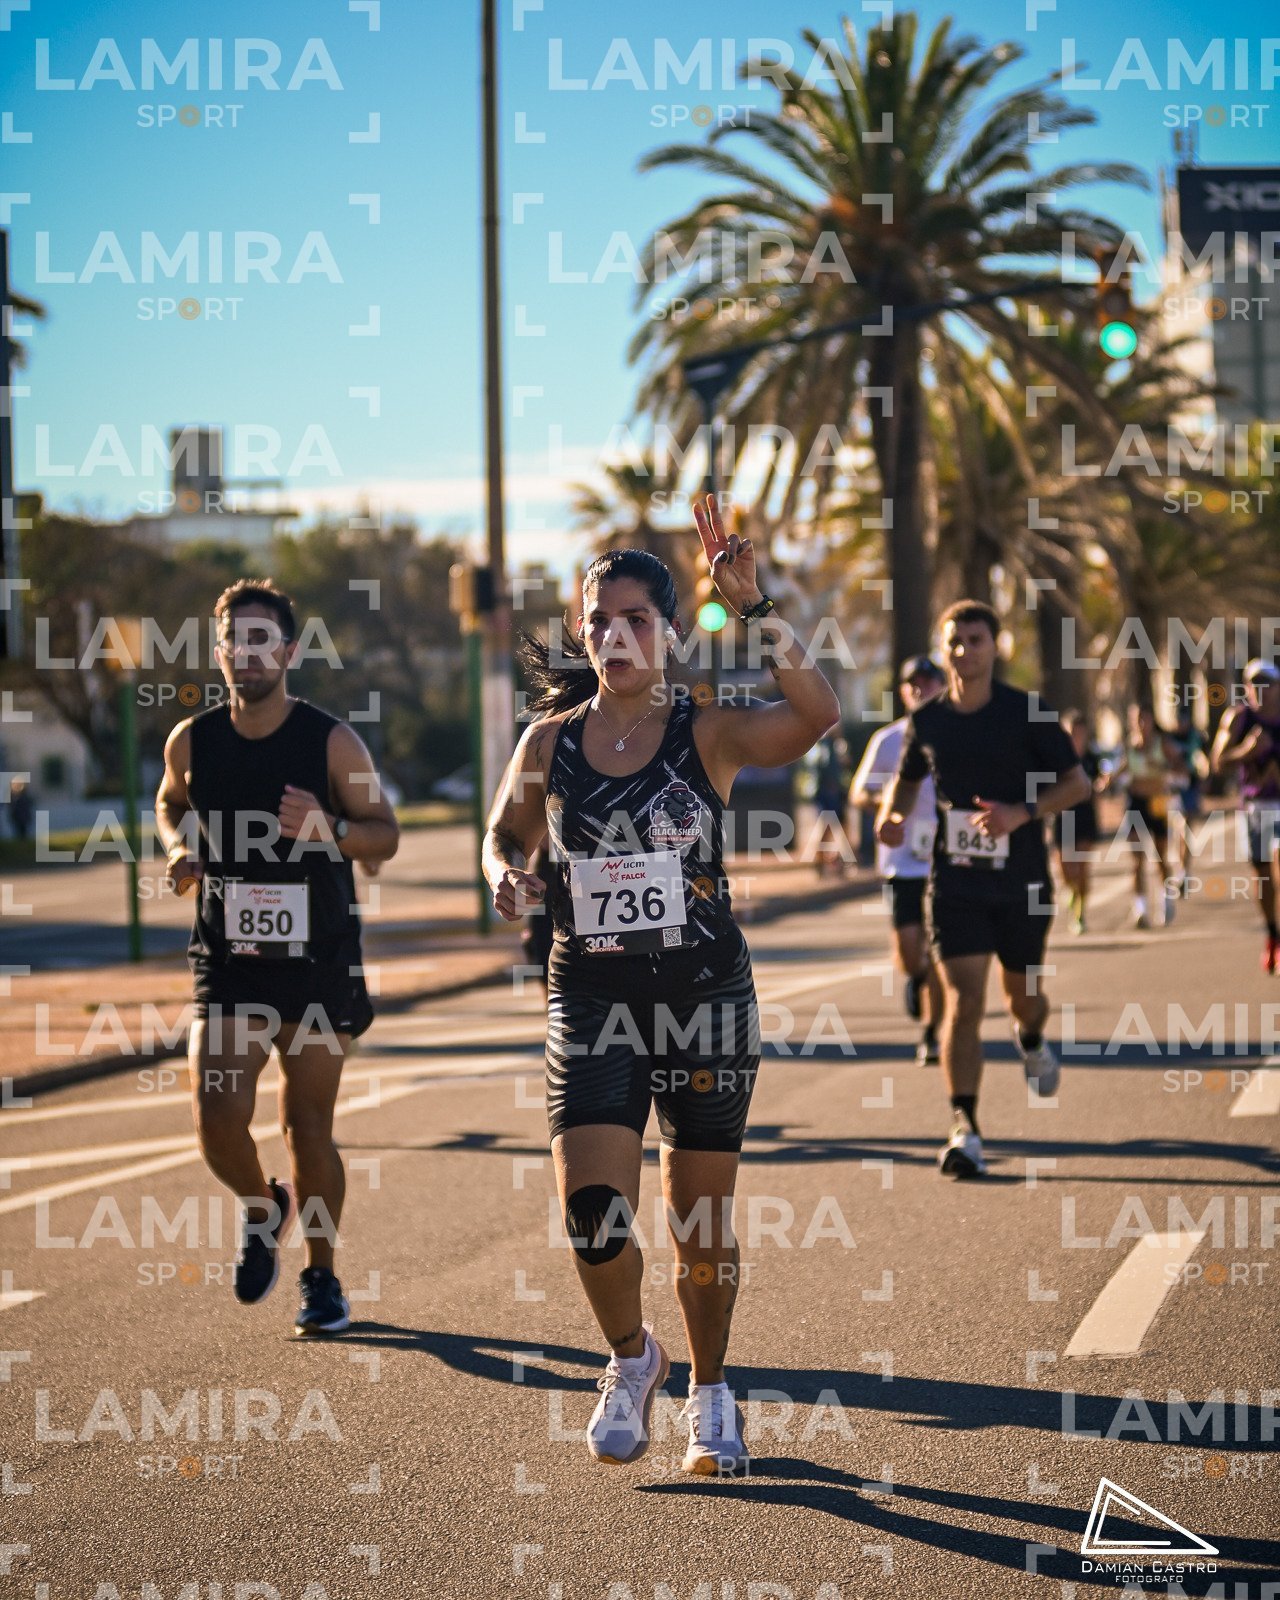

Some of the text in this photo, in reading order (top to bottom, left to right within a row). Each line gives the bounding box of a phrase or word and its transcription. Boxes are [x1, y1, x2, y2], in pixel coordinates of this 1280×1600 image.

[651, 827, 700, 836] BLACK SHEEP
[957, 830, 998, 852] 843
[623, 861, 645, 869] ucm
[621, 872, 646, 881] FALCK
[590, 887, 666, 927] 736
[238, 909, 293, 937] 850
[230, 941, 258, 954] 30K
[585, 934, 619, 953] 30K
